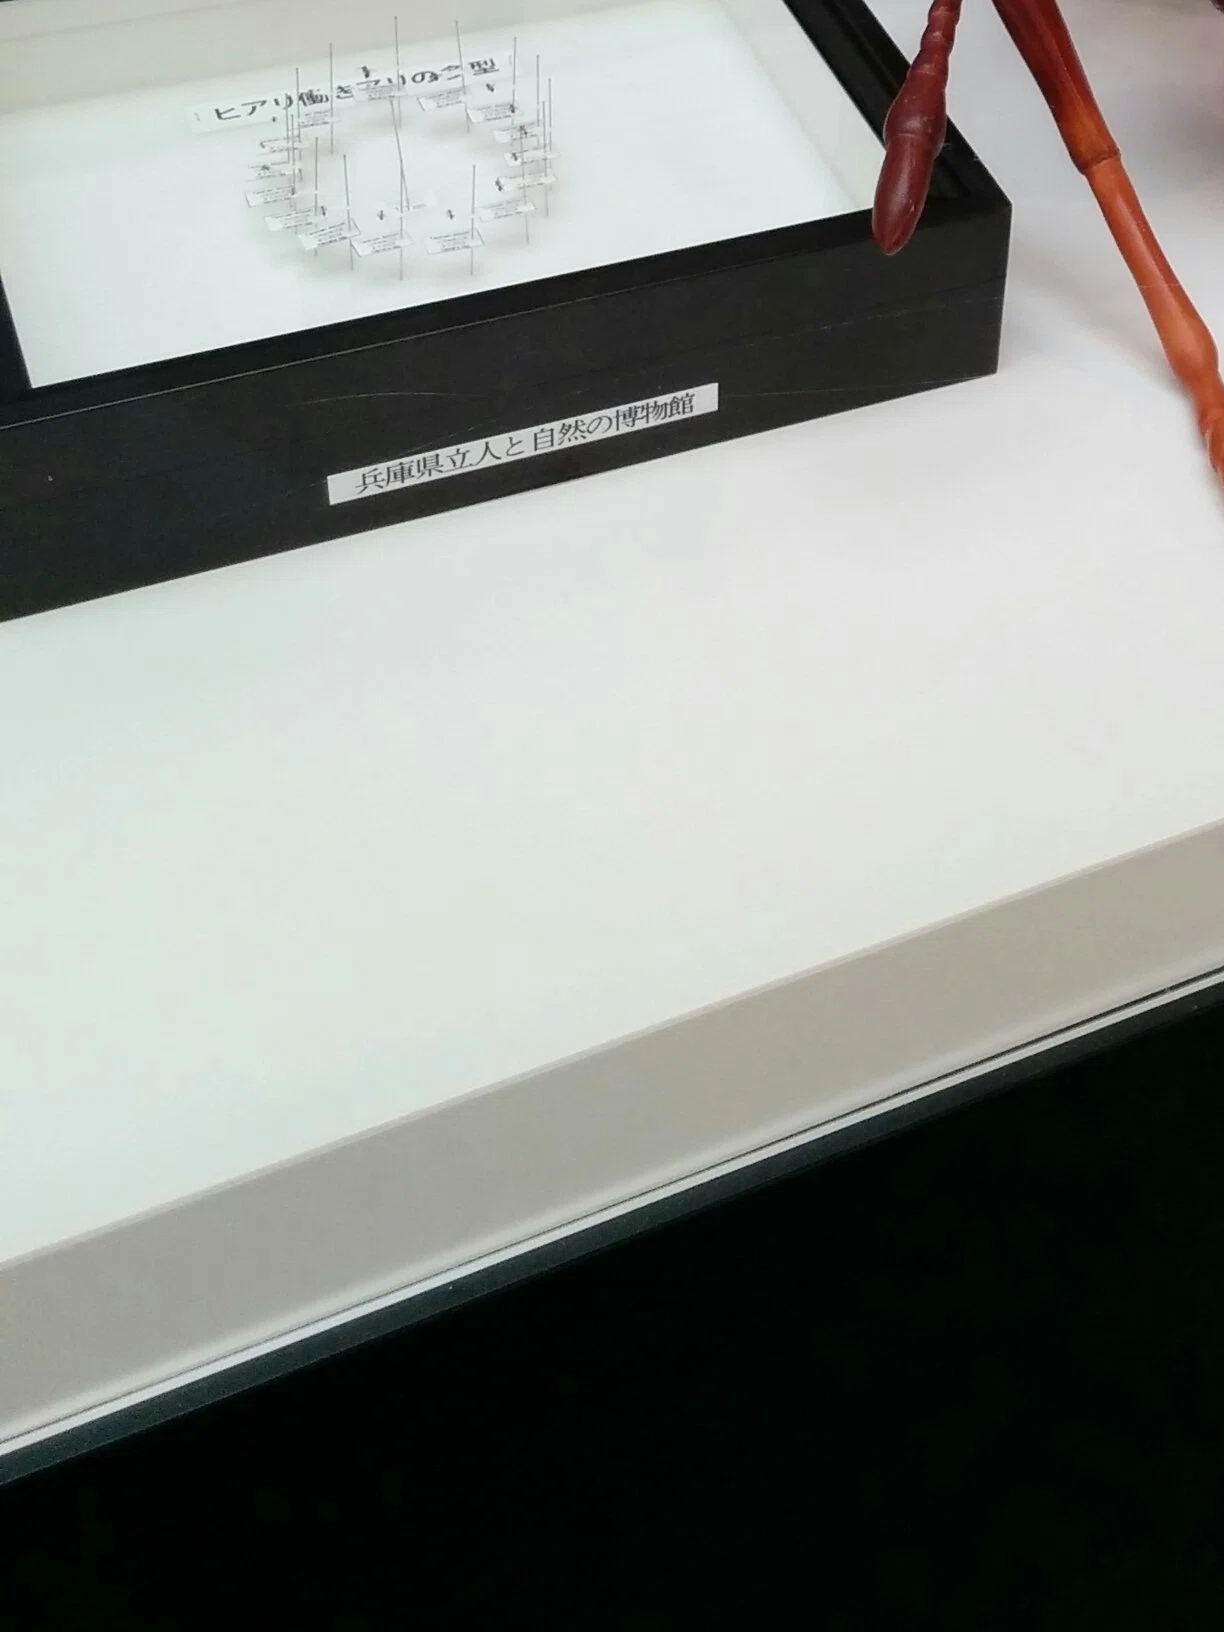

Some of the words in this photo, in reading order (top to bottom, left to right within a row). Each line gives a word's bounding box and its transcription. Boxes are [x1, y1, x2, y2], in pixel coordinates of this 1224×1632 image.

[355, 392, 695, 495] 兵庫県立人と自然の博物館
